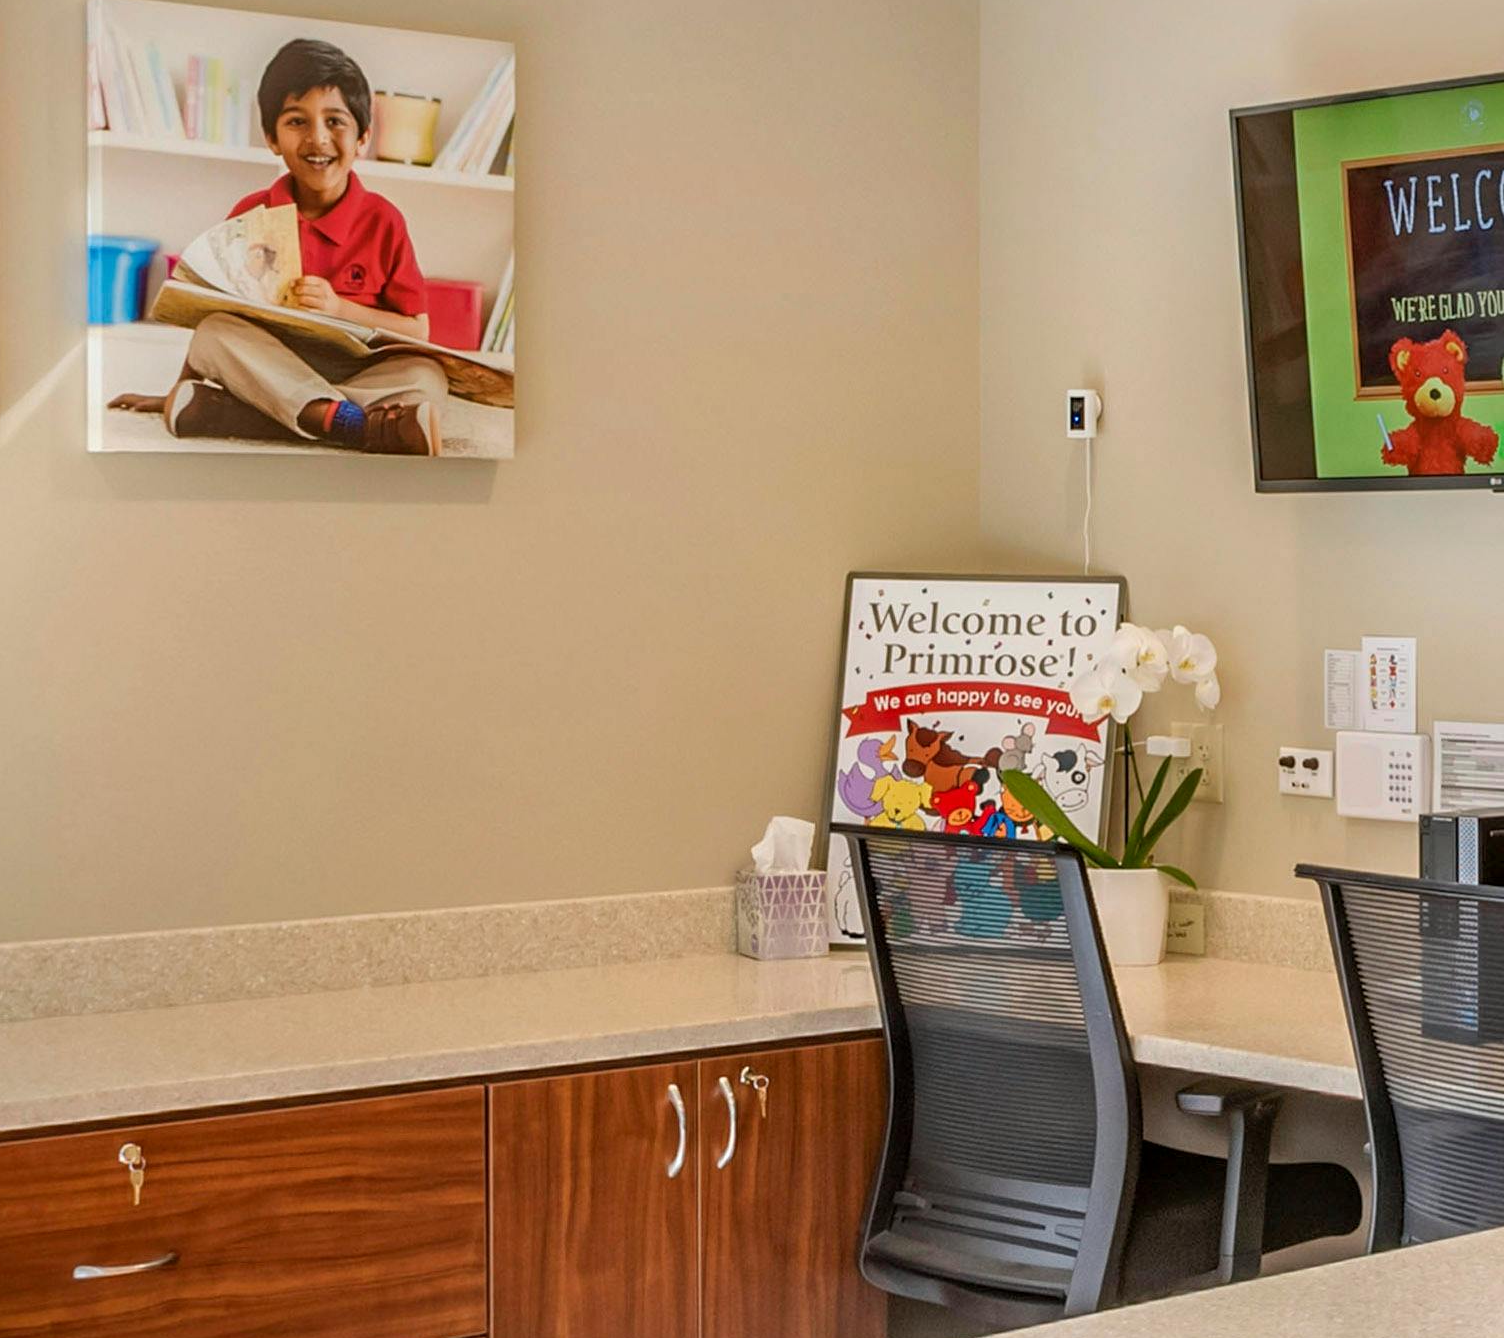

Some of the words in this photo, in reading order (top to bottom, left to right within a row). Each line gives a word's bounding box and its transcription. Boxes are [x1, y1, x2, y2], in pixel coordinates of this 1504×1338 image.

[1391, 294, 1436, 323] WE'RE
[1439, 291, 1475, 321] GLAD
[869, 601, 1046, 637] Welcome
[1059, 610, 1097, 637] to
[874, 695, 900, 712] We
[905, 692, 932, 707] are
[937, 688, 991, 707] happy
[994, 689, 1009, 706] to
[1013, 694, 1043, 710] see
